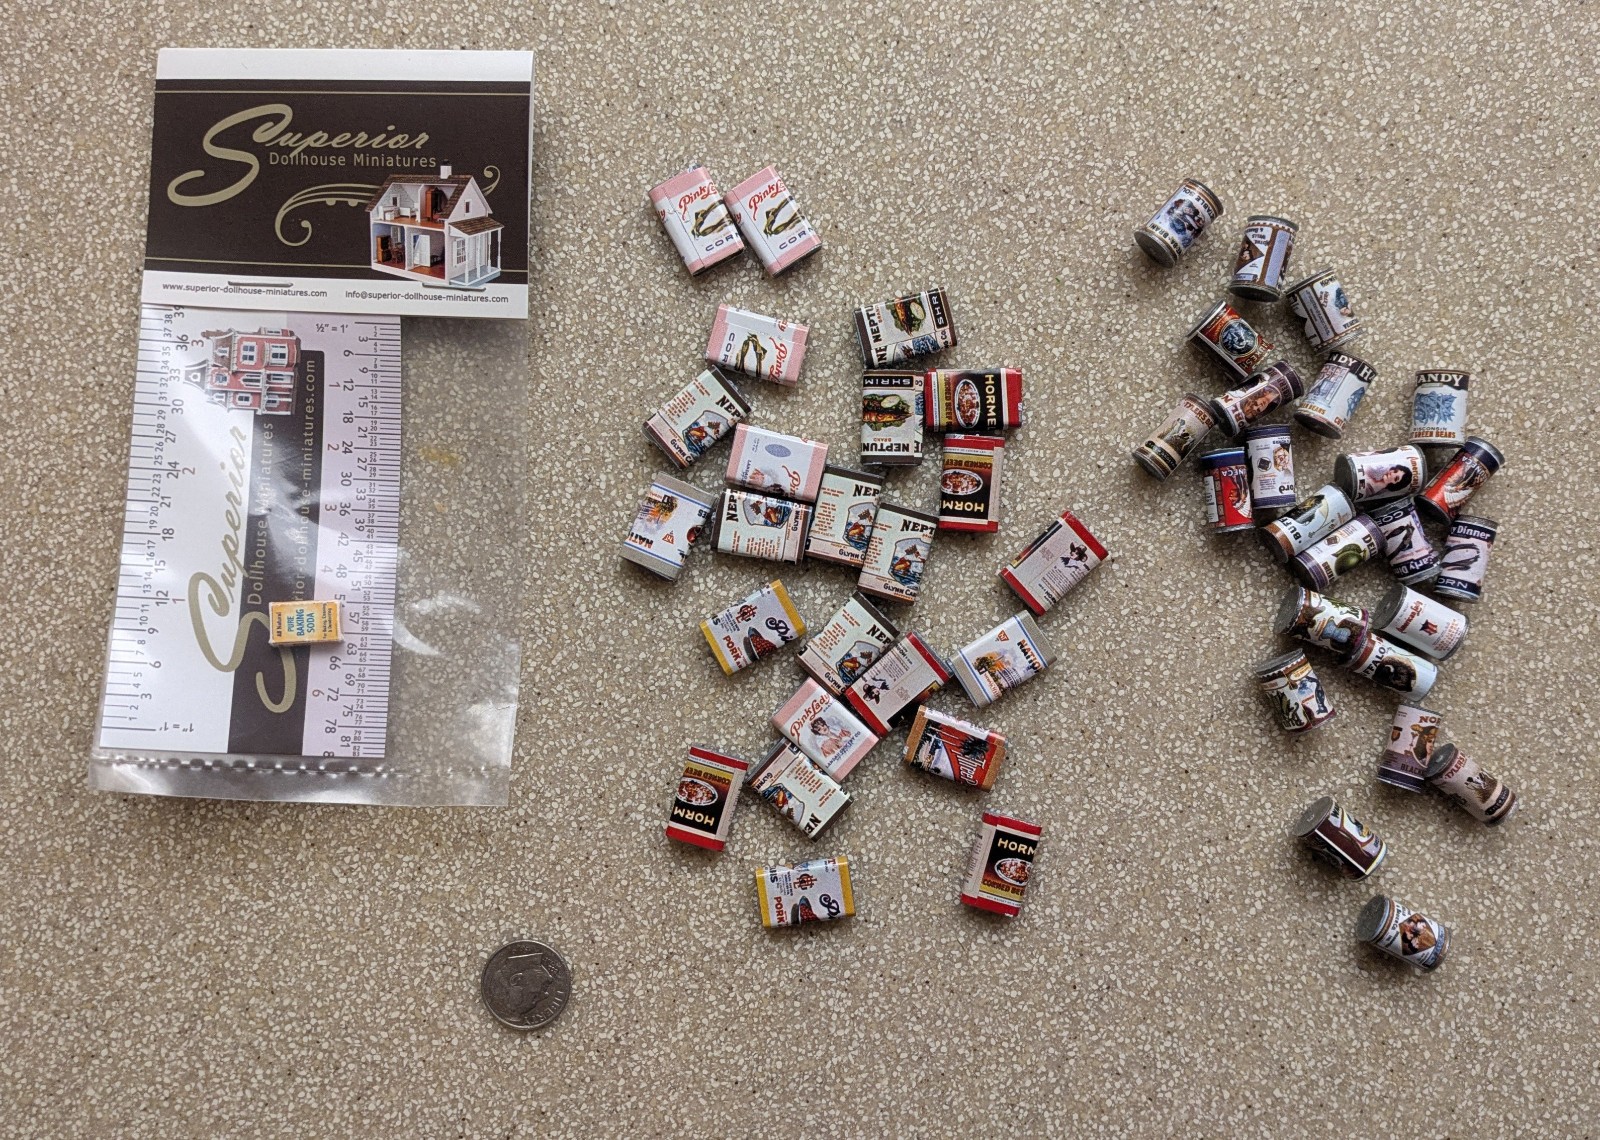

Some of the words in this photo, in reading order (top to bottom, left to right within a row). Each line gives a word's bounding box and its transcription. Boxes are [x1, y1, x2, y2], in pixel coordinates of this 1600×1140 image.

[167, 103, 430, 207] Superior
[269, 151, 346, 167] Dollhouse
[353, 152, 436, 168] Miniatures
[678, 184, 707, 221] Pink
[748, 184, 775, 221] Pink
[162, 283, 328, 298] www.superior-dollhouse-miniatures.com
[345, 290, 509, 304] info@superior-dollhouse-miniatures.com
[164, 314, 173, 324] 38
[163, 327, 172, 338] 37
[176, 334, 189, 351] 36
[162, 346, 170, 356] 35
[769, 337, 788, 378] Pink
[161, 360, 170, 370] 34
[169, 368, 180, 382] 33
[864, 377, 911, 385] SHRIM
[160, 377, 168, 388] 32
[343, 378, 354, 391] 12
[159, 391, 167, 401] 31
[358, 395, 368, 408] 15
[984, 374, 997, 430] HORMEL
[171, 399, 184, 414] 30
[157, 409, 166, 420] 29
[342, 410, 353, 424] 18
[156, 423, 165, 434] 28
[357, 426, 368, 439] 21
[1435, 431, 1456, 439] BEANS
[165, 430, 176, 443] 27
[155, 441, 164, 452] 26
[342, 441, 353, 454] 24
[862, 442, 910, 453] NEPTUN
[153, 455, 163, 465] 25
[357, 457, 367, 471] 27
[167, 461, 179, 479] 24
[153, 473, 162, 484] 23
[340, 472, 352, 487] 30
[1357, 465, 1365, 500] TEA
[152, 486, 160, 497] 22
[356, 488, 366, 501] 33
[160, 495, 171, 508] 21
[150, 506, 159, 517] 20
[339, 502, 351, 516] 36
[149, 520, 157, 529] 19
[355, 518, 365, 532] 39
[900, 519, 935, 536] NEPT
[162, 528, 174, 541] 18
[338, 532, 349, 546] 42
[1457, 525, 1491, 540] Dinner
[147, 540, 156, 549] 17
[146, 552, 155, 561] 16
[353, 549, 363, 563] 45
[838, 549, 860, 560] GLYNN
[155, 560, 166, 572] 15
[247, 520, 268, 605] Dollhouse
[144, 571, 153, 581] 14
[336, 563, 347, 578] 48
[143, 584, 152, 594] 13
[351, 580, 361, 591] 51
[883, 582, 905, 593] GLYNN
[155, 590, 169, 607] 12
[141, 604, 150, 613] 11
[139, 615, 148, 626] 10
[296, 609, 305, 636] BAKING
[306, 612, 315, 633] SODA
[349, 611, 360, 624] 57
[346, 642, 357, 655] 63
[722, 635, 739, 662] PORK
[329, 656, 341, 670] 66
[345, 673, 355, 686] 69
[327, 687, 339, 702] 72
[342, 704, 353, 717] 75
[790, 707, 813, 746] Pink
[809, 693, 831, 721] Lady
[325, 719, 337, 734] 78
[341, 735, 351, 747] 81
[673, 806, 715, 827] HORM
[773, 896, 786, 924] PORK
